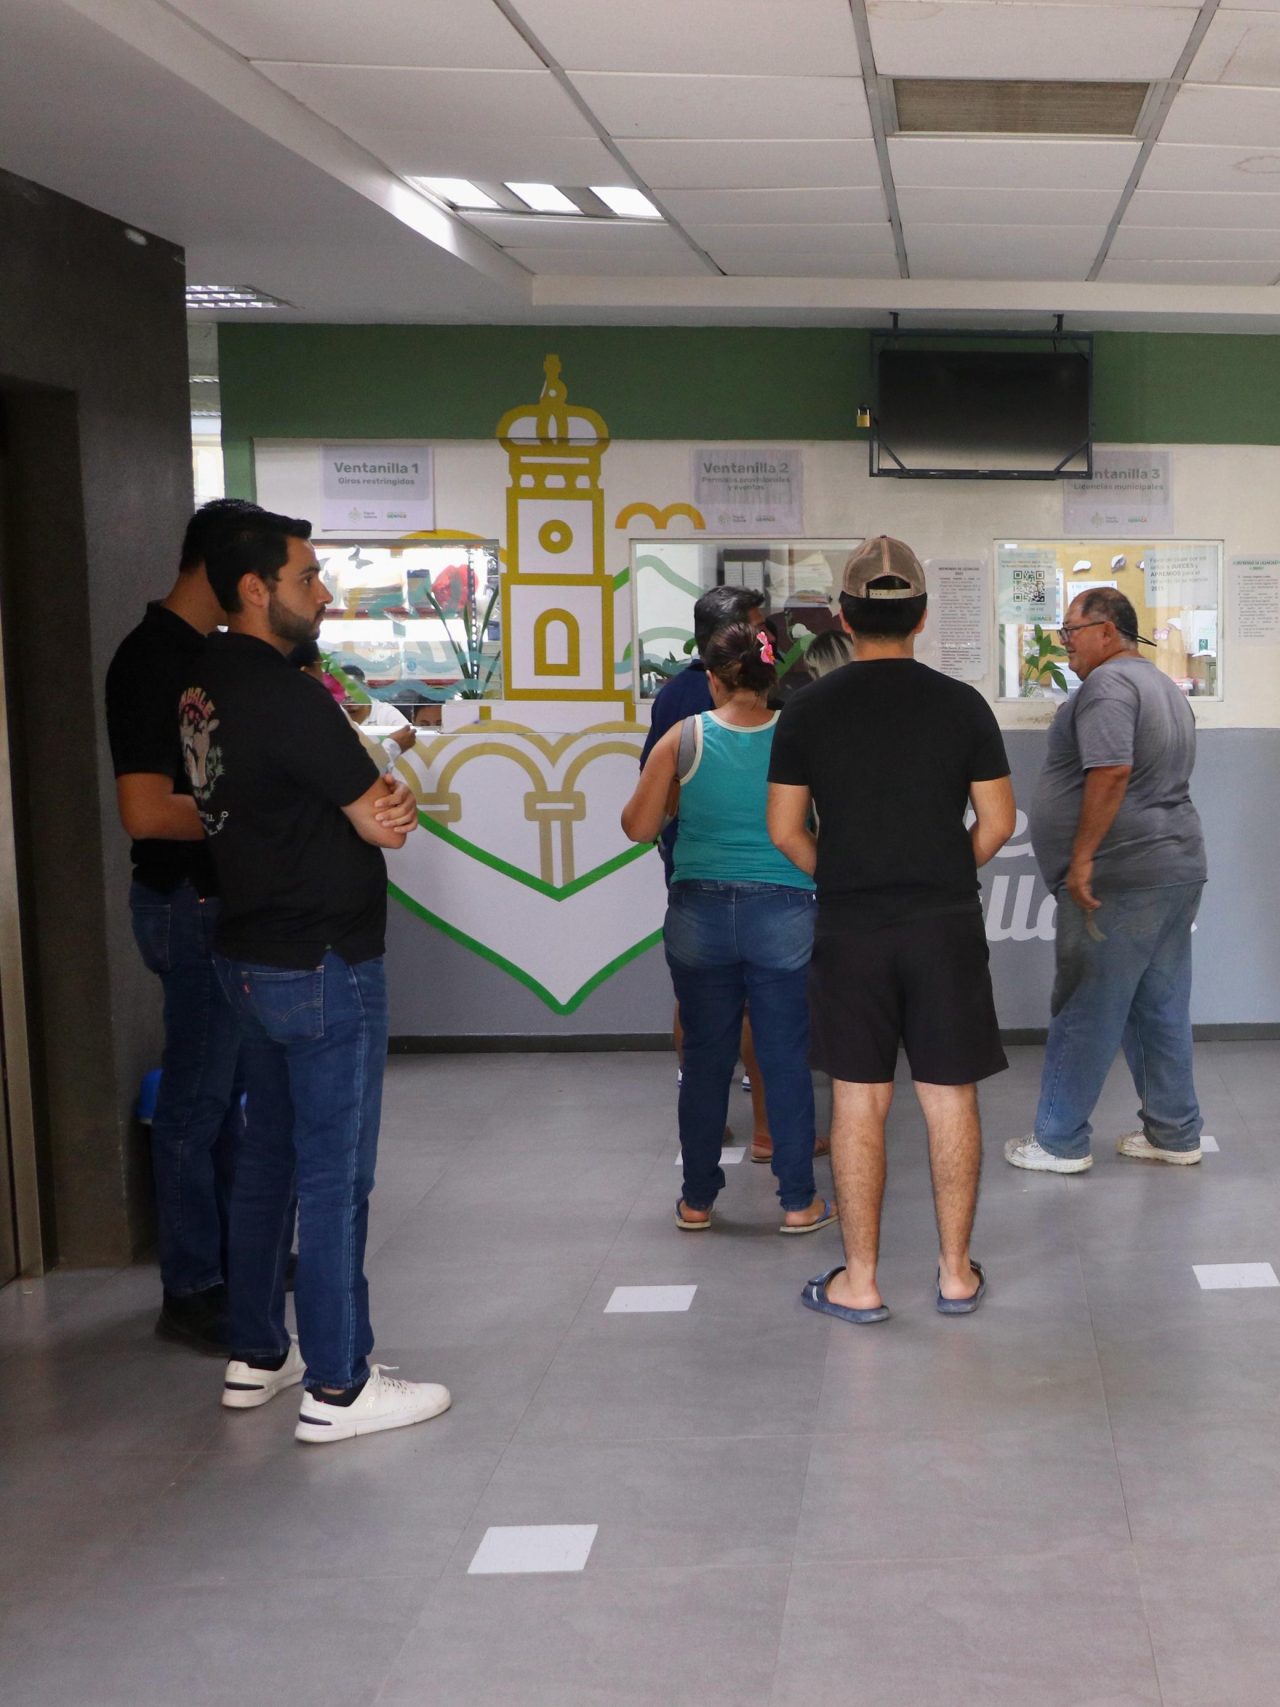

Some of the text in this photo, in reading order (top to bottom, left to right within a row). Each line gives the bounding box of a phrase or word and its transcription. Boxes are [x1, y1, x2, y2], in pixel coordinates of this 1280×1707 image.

[333, 462, 419, 474] Ventanilla 1
[703, 462, 789, 474] Ventanilla 2
[1094, 468, 1160, 480] ntanilla 3
[363, 477, 415, 487] restringidos
[1114, 483, 1164, 491] municipales
